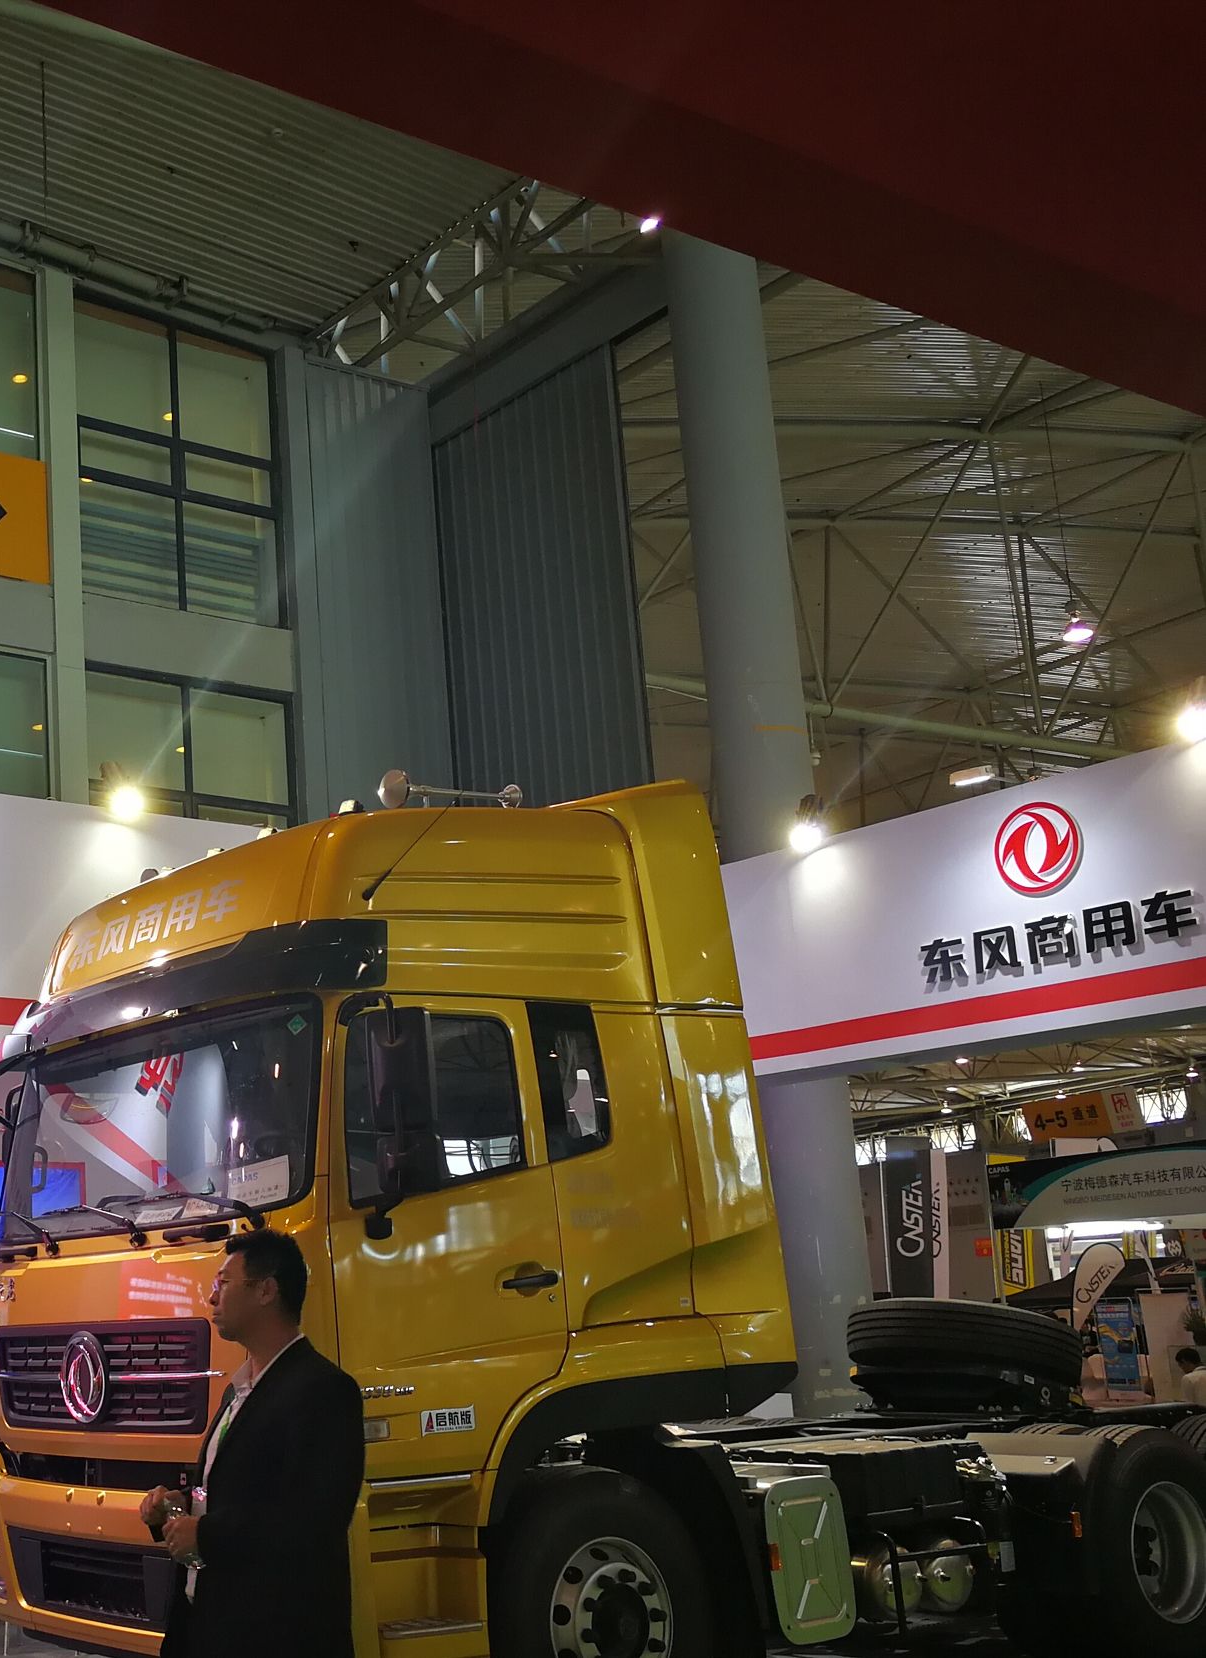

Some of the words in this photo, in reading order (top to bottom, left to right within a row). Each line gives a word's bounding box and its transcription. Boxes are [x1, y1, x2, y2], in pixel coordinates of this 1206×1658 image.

[69, 879, 245, 973] 东风商用车
[921, 890, 1196, 983] 东风商用车
[1034, 1110, 1068, 1131] 4-5
[1127, 1189, 1173, 1200] AUTOMOBILE
[435, 1410, 472, 1427] 启航版
